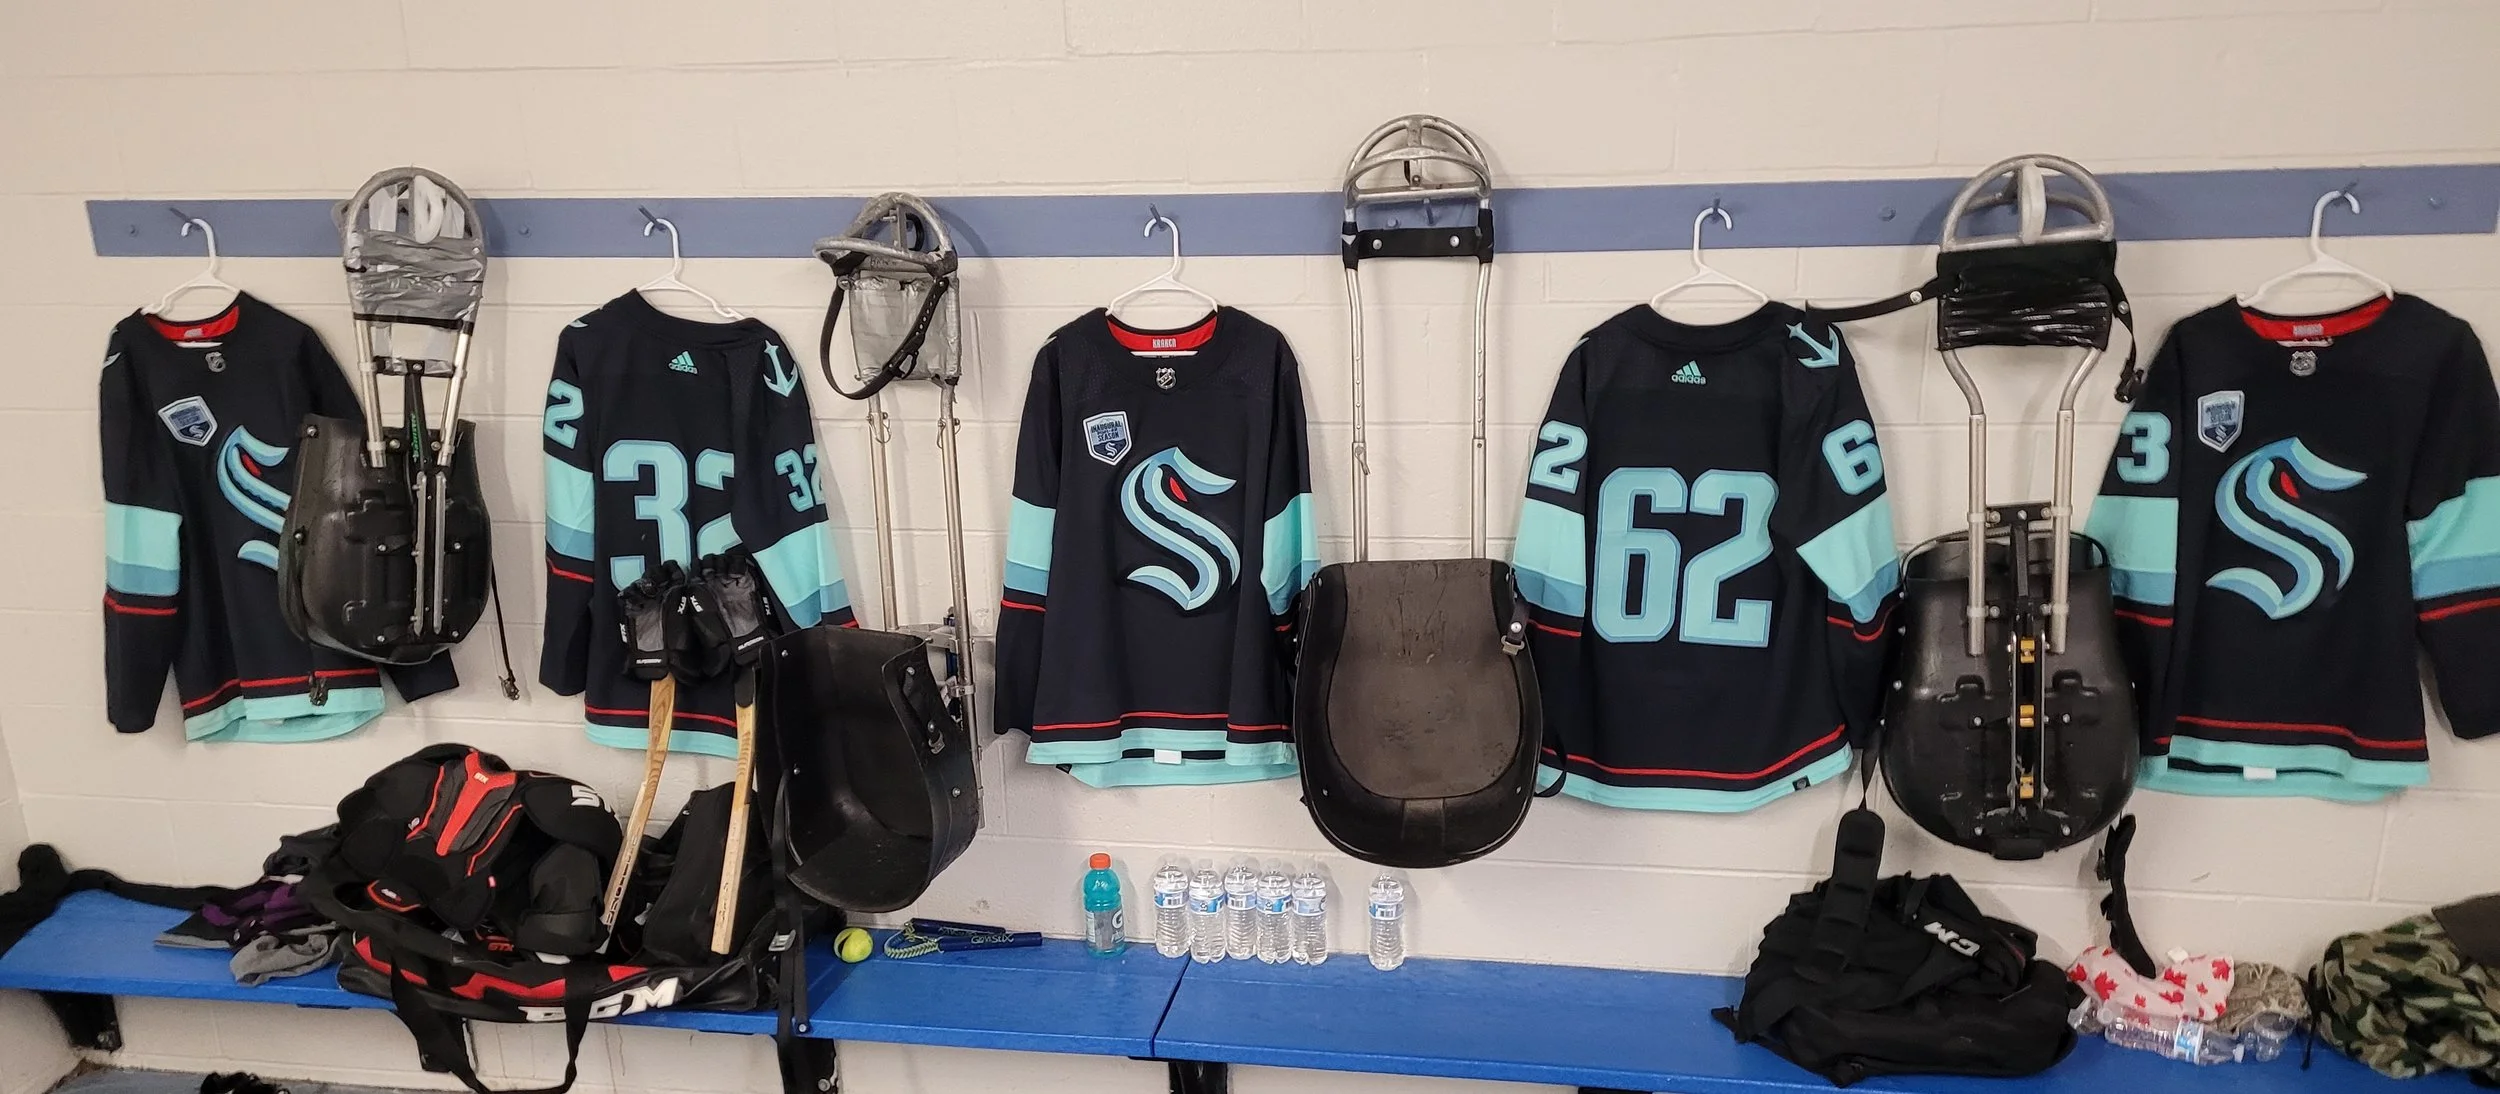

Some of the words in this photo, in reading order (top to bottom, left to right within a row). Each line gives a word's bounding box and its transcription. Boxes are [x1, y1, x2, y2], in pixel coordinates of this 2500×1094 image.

[668, 362, 698, 375] adidas
[1671, 374, 1706, 385] adidas
[544, 378, 585, 450] 2
[1091, 420, 1122, 433] INAUGURAL
[1098, 431, 1119, 441] SEASON
[2116, 411, 2172, 485] 3
[1529, 419, 1588, 495] 2
[1822, 419, 1885, 496] 6
[774, 443, 826, 513] 32
[1591, 467, 1780, 648] 62
[677, 595, 687, 615] STX
[689, 595, 703, 613] STX
[762, 596, 771, 616] STX
[1923, 921, 1981, 957] CM
